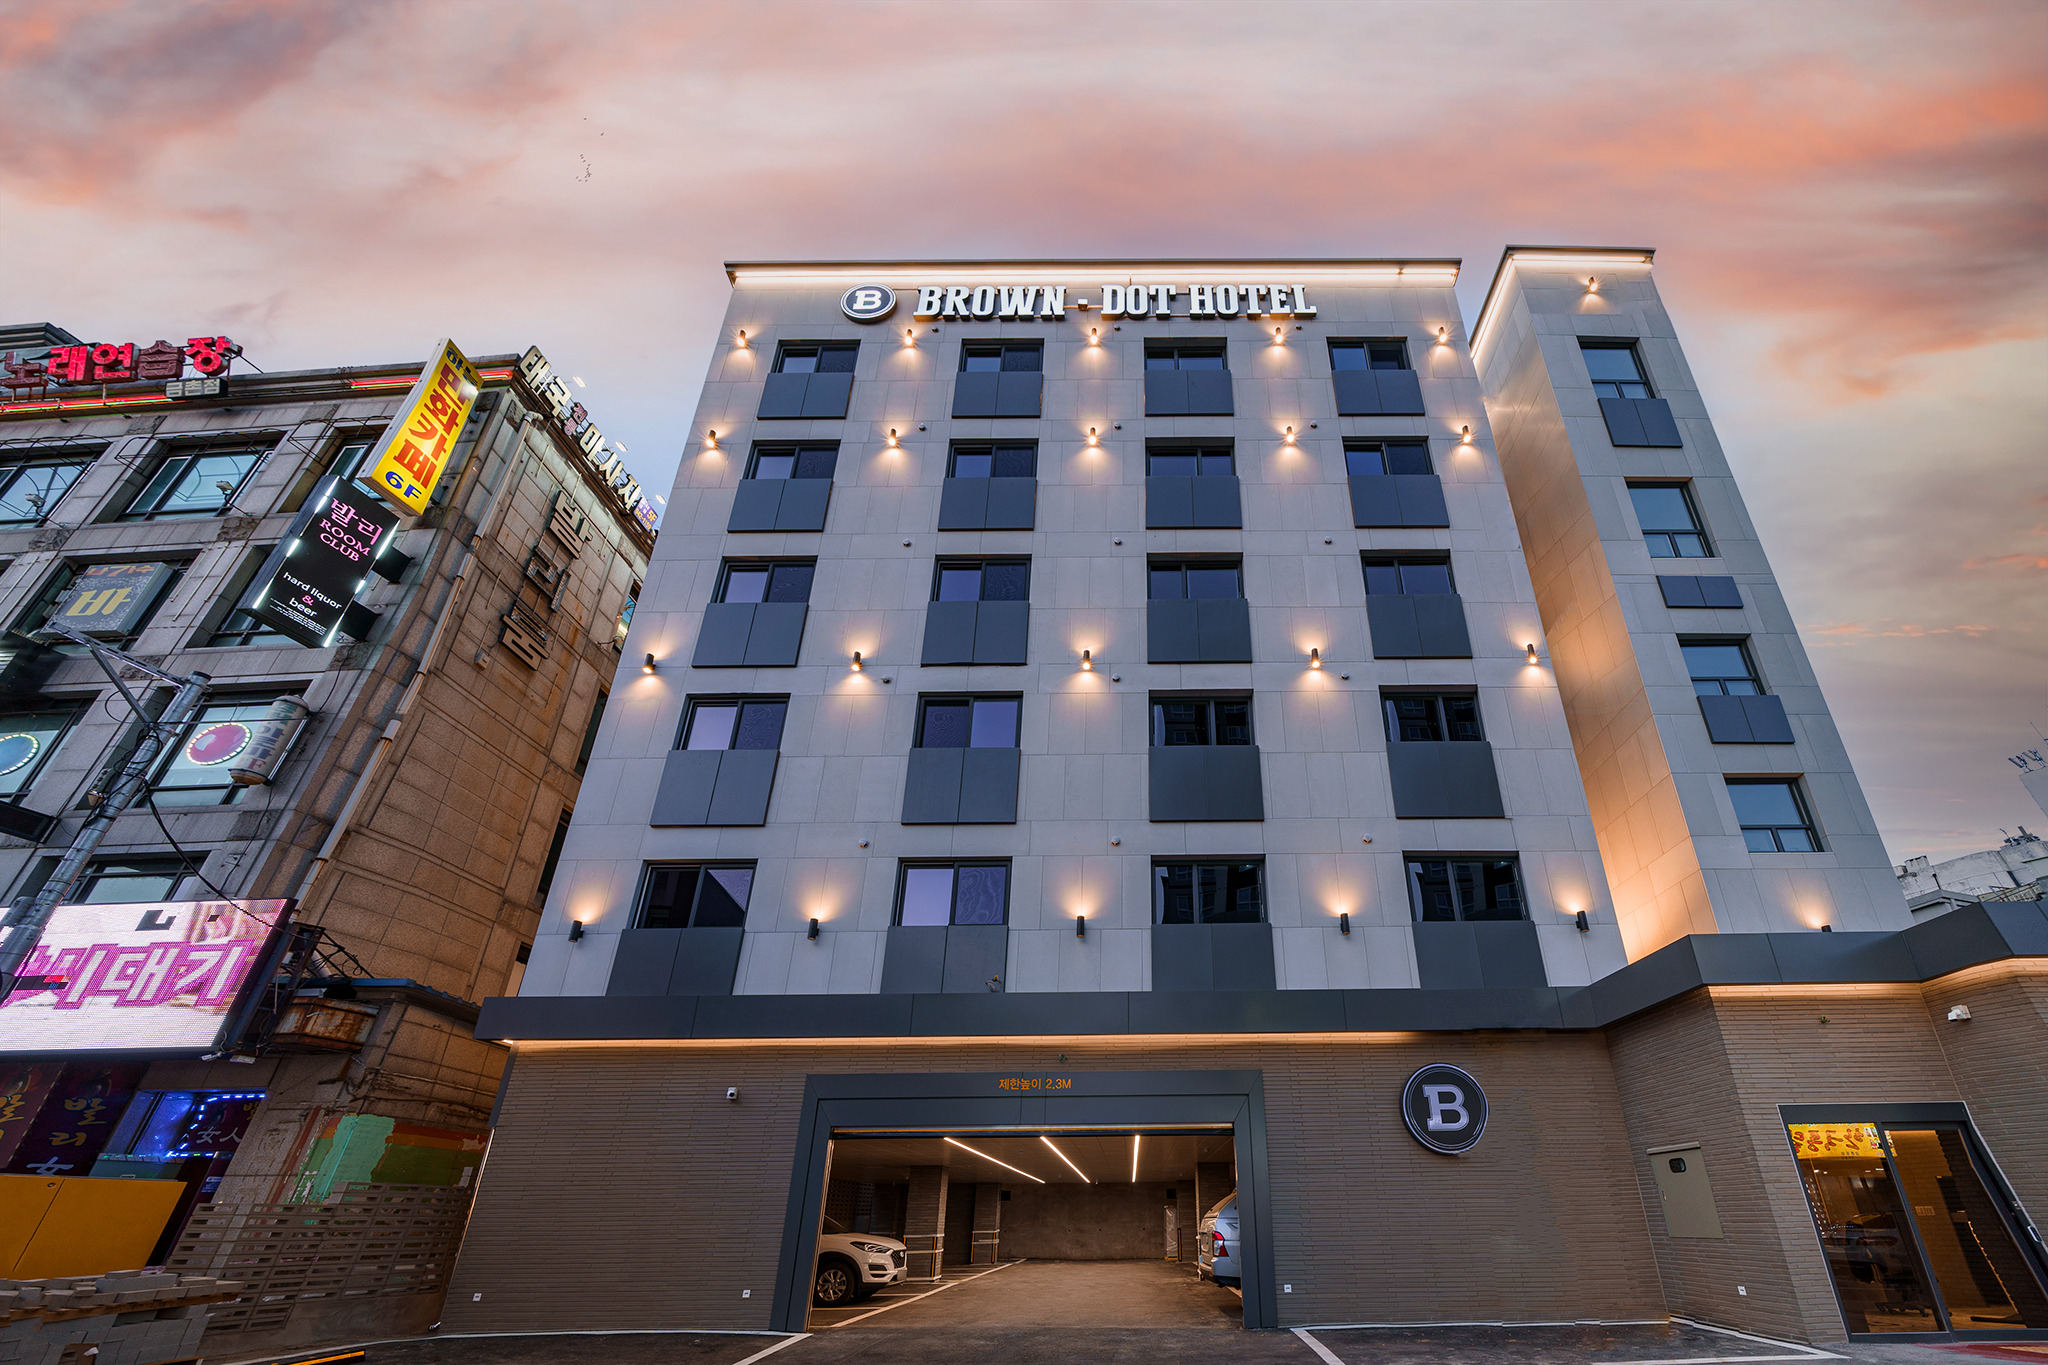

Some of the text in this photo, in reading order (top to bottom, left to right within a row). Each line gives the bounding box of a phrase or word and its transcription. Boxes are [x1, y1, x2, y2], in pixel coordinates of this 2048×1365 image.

[852, 284, 1317, 320] B BROWN DOT HOTEL
[1, 336, 234, 388] 노래연습장
[166, 378, 220, 397] 금촌점
[393, 363, 471, 489] 만화카페
[520, 346, 572, 417] 태국
[579, 424, 643, 511] 마사지
[385, 471, 422, 499] 6F
[330, 498, 383, 545] 발리
[646, 509, 658, 522] 5F
[319, 518, 372, 556] ROOM
[319, 532, 360, 562] CLUB
[66, 587, 132, 616] 바
[283, 571, 343, 609] hard liquor
[302, 594, 314, 606] &
[289, 597, 318, 618] beer
[998, 1078, 1072, 1090] 제한높이 2.3M
[1422, 1084, 1470, 1131] B
